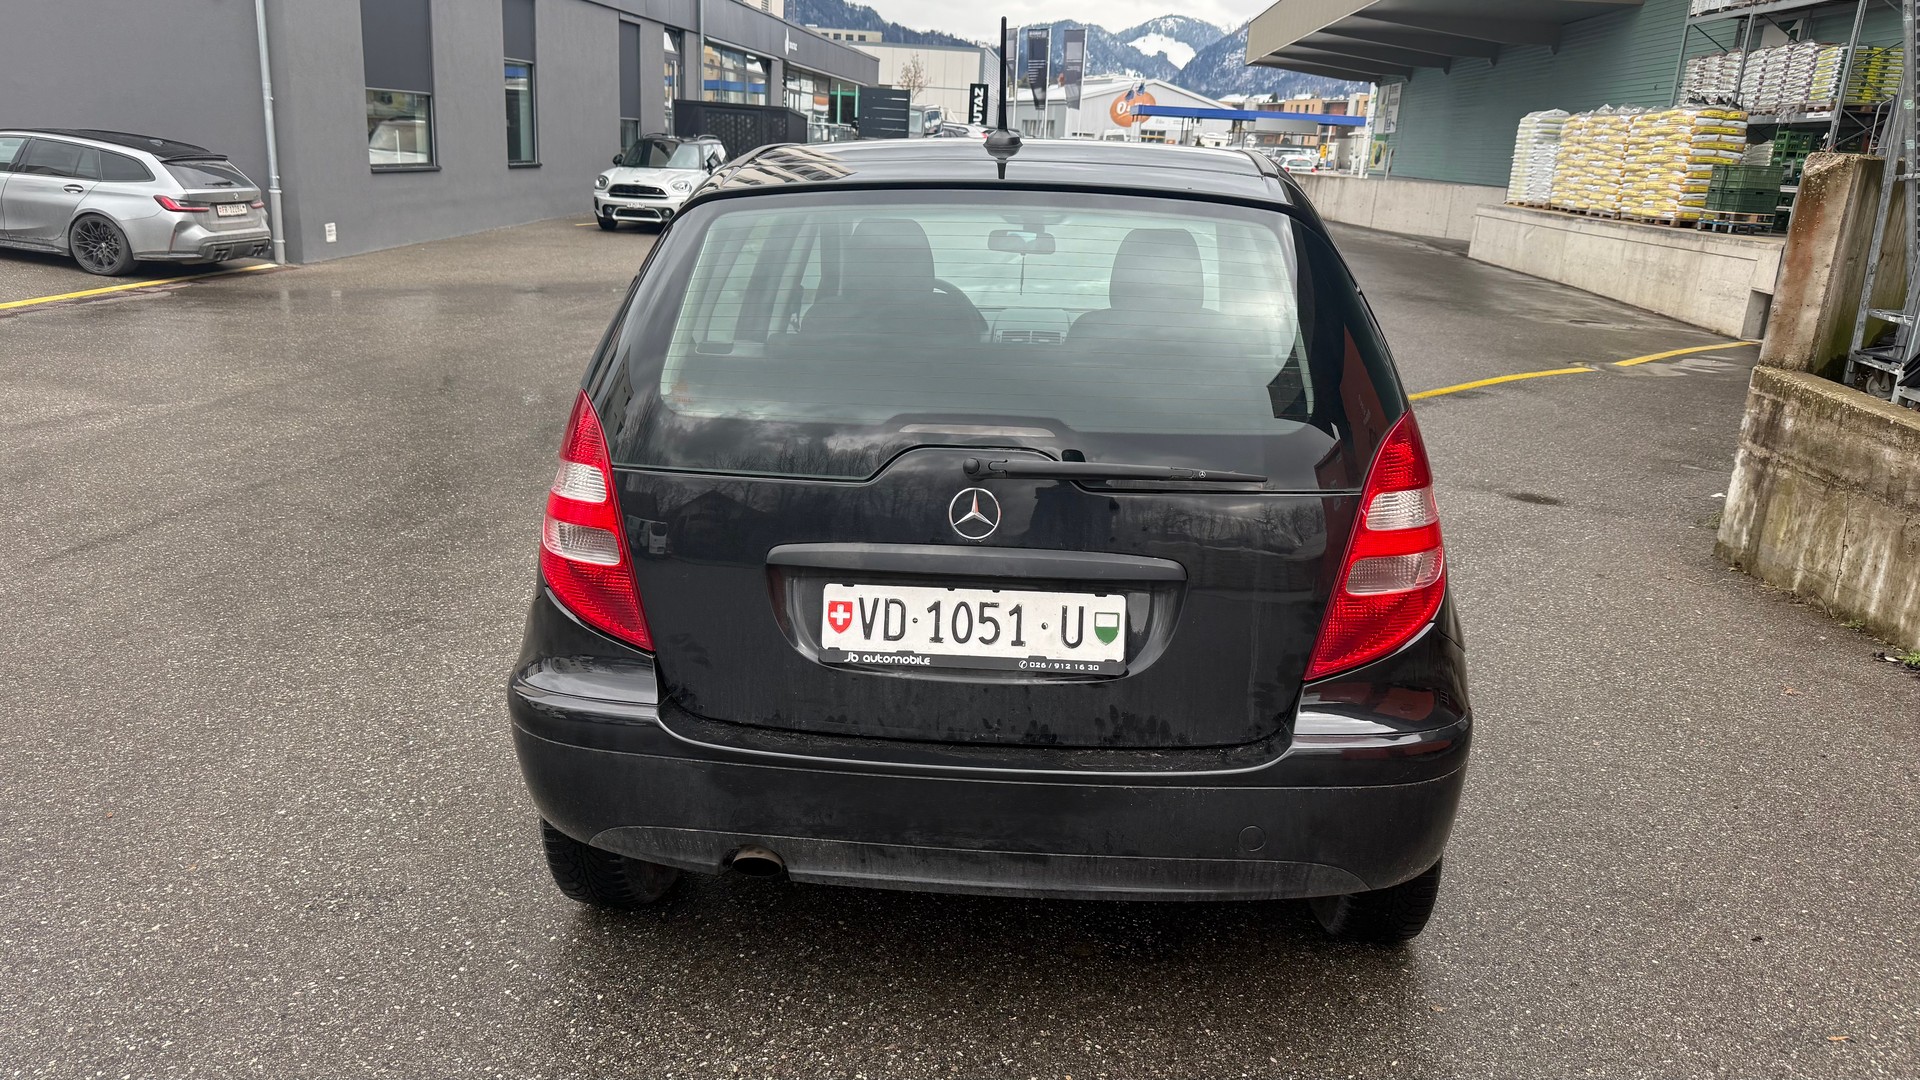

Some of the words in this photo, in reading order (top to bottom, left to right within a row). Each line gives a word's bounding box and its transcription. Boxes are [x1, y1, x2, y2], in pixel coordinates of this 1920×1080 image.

[859, 597, 906, 641] VD
[927, 600, 1026, 647] 1051
[1061, 605, 1084, 649] U
[862, 654, 931, 665] automobile
